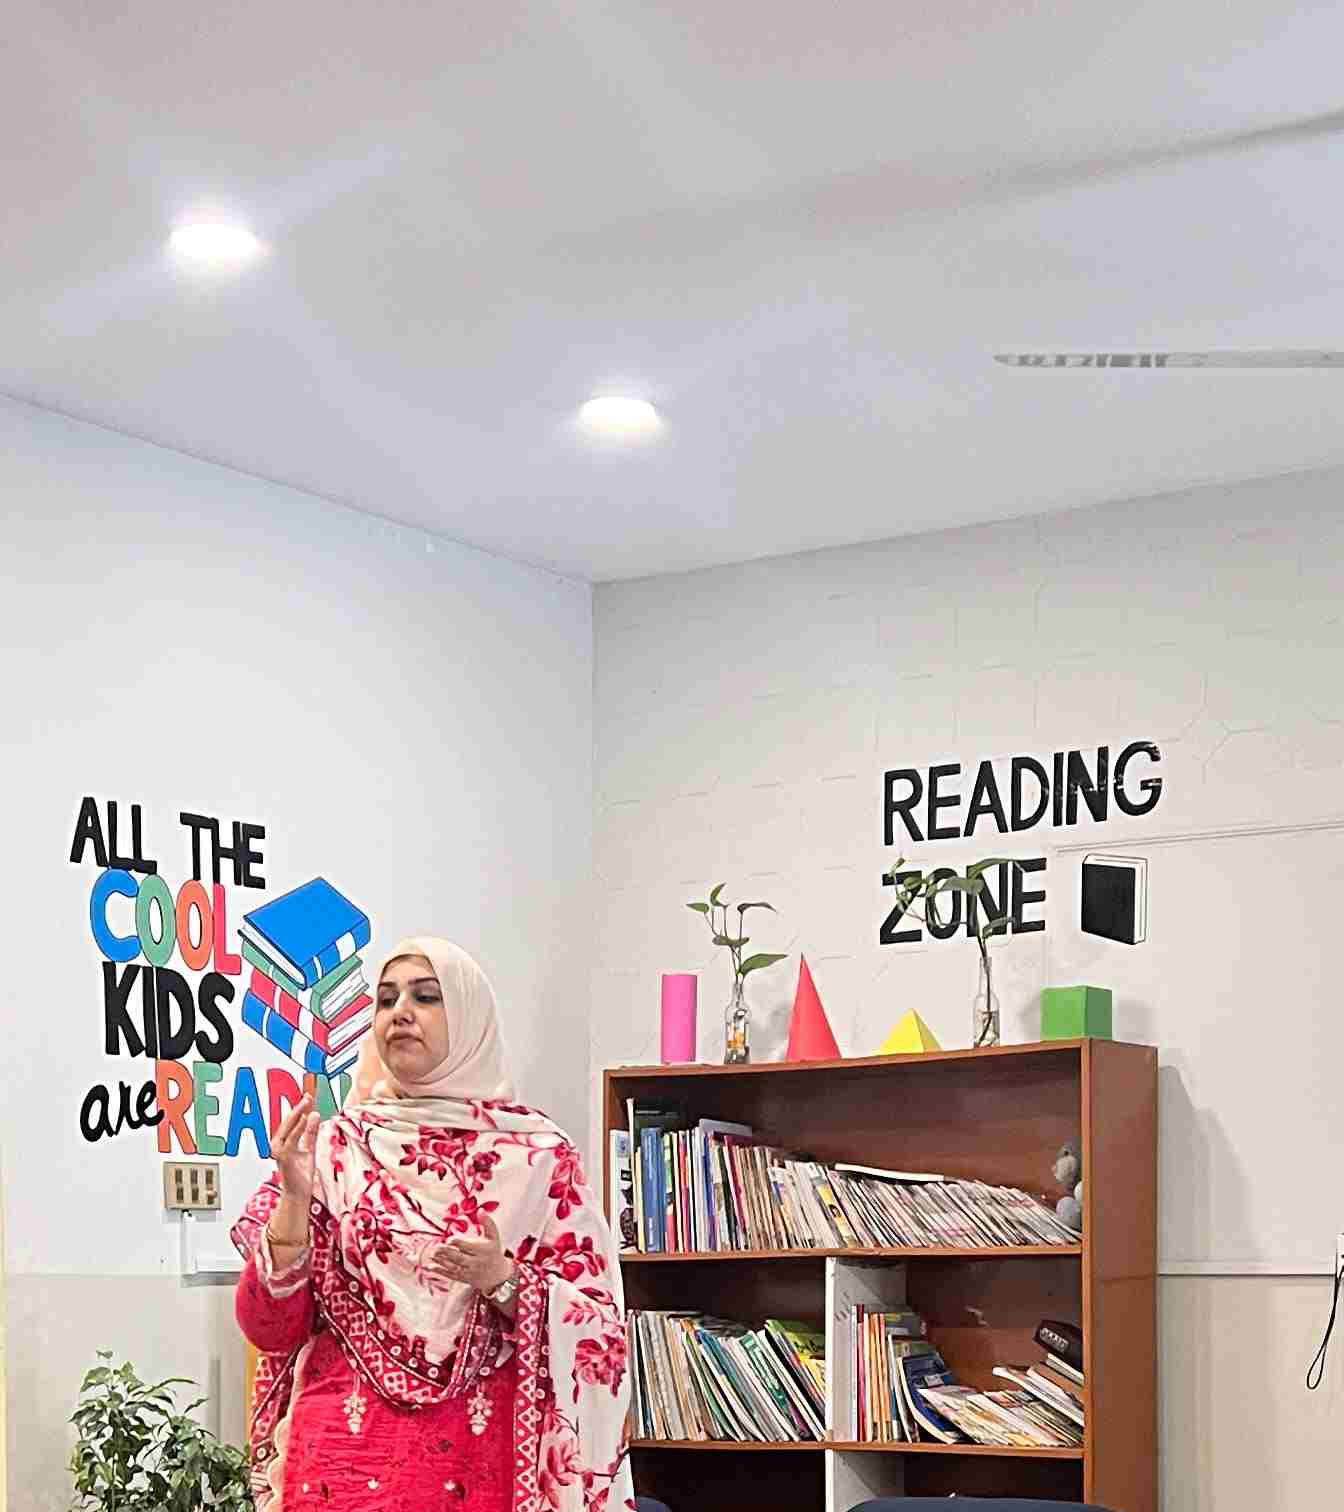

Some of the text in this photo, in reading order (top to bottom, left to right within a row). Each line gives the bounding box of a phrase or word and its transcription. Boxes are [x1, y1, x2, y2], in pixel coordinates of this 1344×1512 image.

[883, 740, 1164, 846] READING
[69, 796, 266, 890] ALL THE
[89, 867, 242, 976] COOL
[879, 856, 1047, 945] ZONE
[102, 960, 236, 1064] KIDS
[79, 1080, 165, 1143] are
